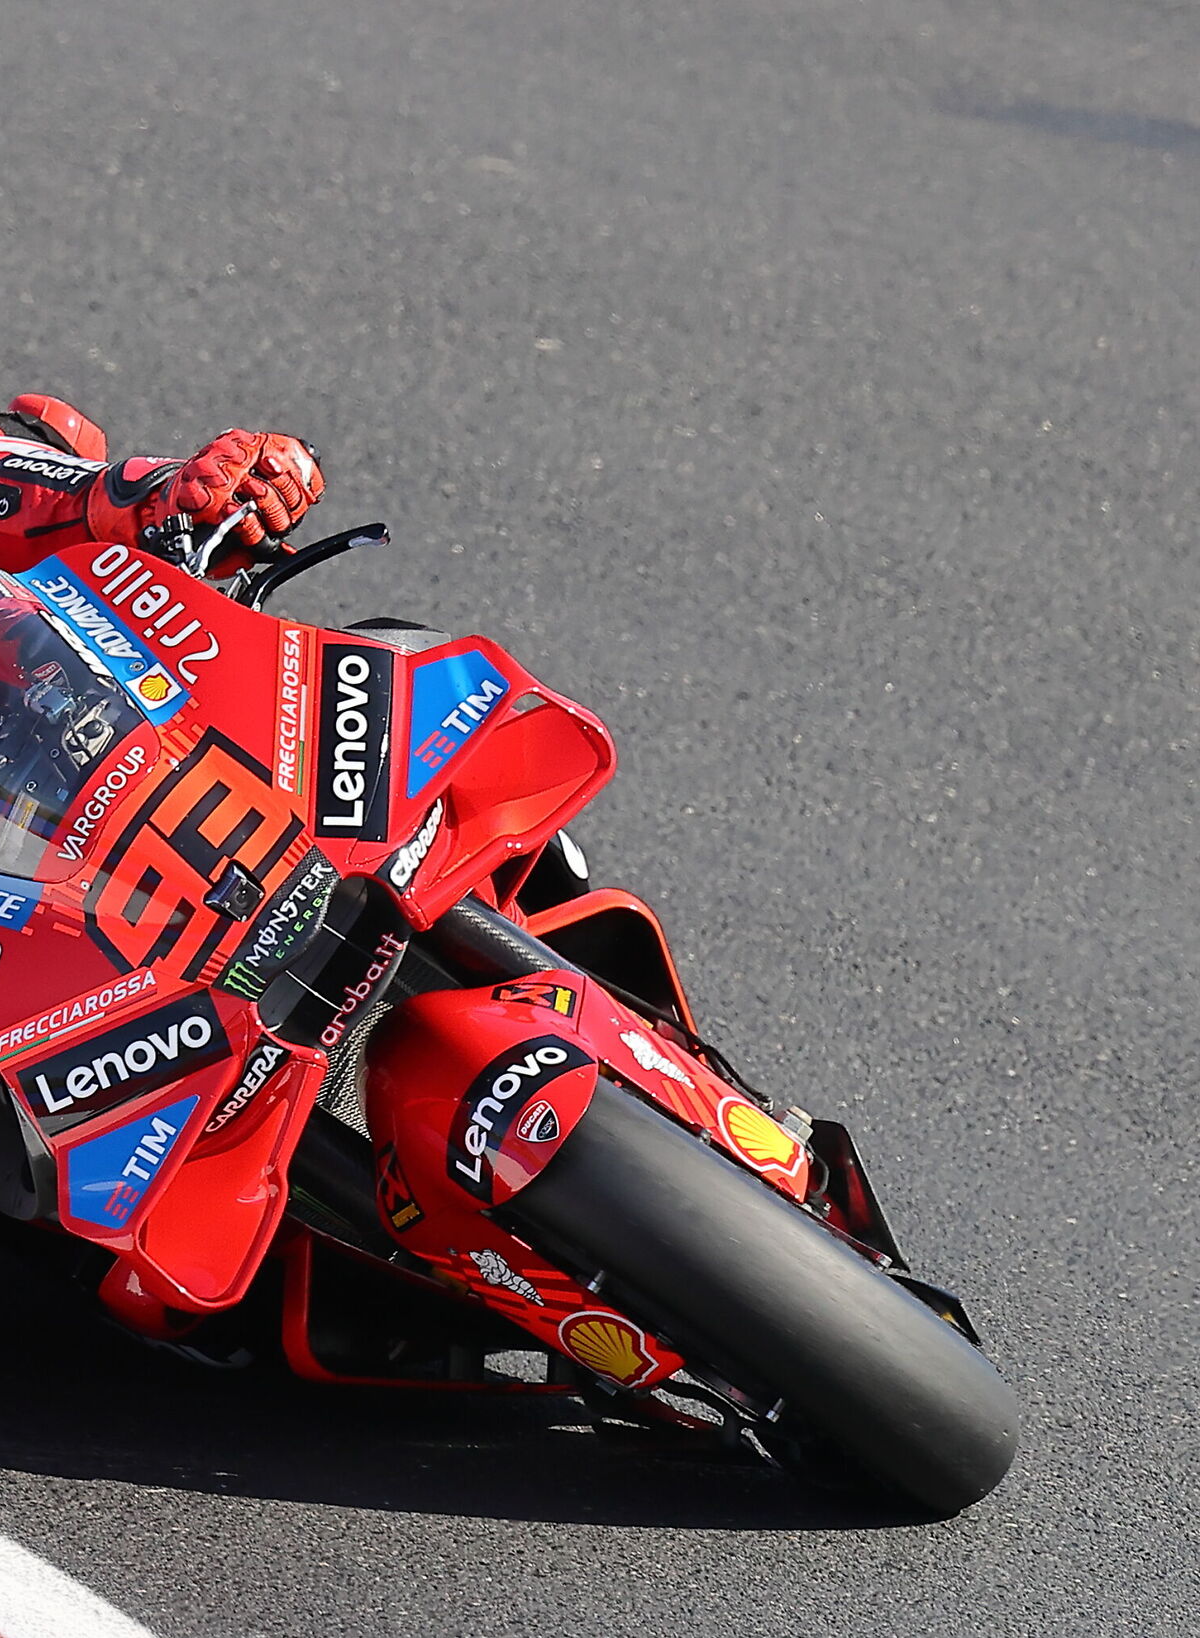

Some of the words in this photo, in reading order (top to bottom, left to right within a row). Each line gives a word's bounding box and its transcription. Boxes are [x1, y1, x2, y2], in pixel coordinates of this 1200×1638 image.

[3, 458, 89, 486] Lenovo
[37, 576, 143, 659] ADVANCE
[277, 630, 301, 793] FRECCIAROSSA
[322, 655, 371, 828] Lenovo
[441, 679, 504, 737] TIM
[58, 745, 146, 861] VARGROUP
[246, 862, 334, 967] MONSTER
[275, 885, 331, 959] ENERGY
[320, 933, 405, 1047] aruba.it
[35, 1016, 212, 1114] Lenovo
[205, 1045, 284, 1133] CARRERA
[122, 1117, 178, 1181] TIM
[456, 1046, 568, 1183] Lenovo
[521, 1104, 545, 1135] DUCATI
